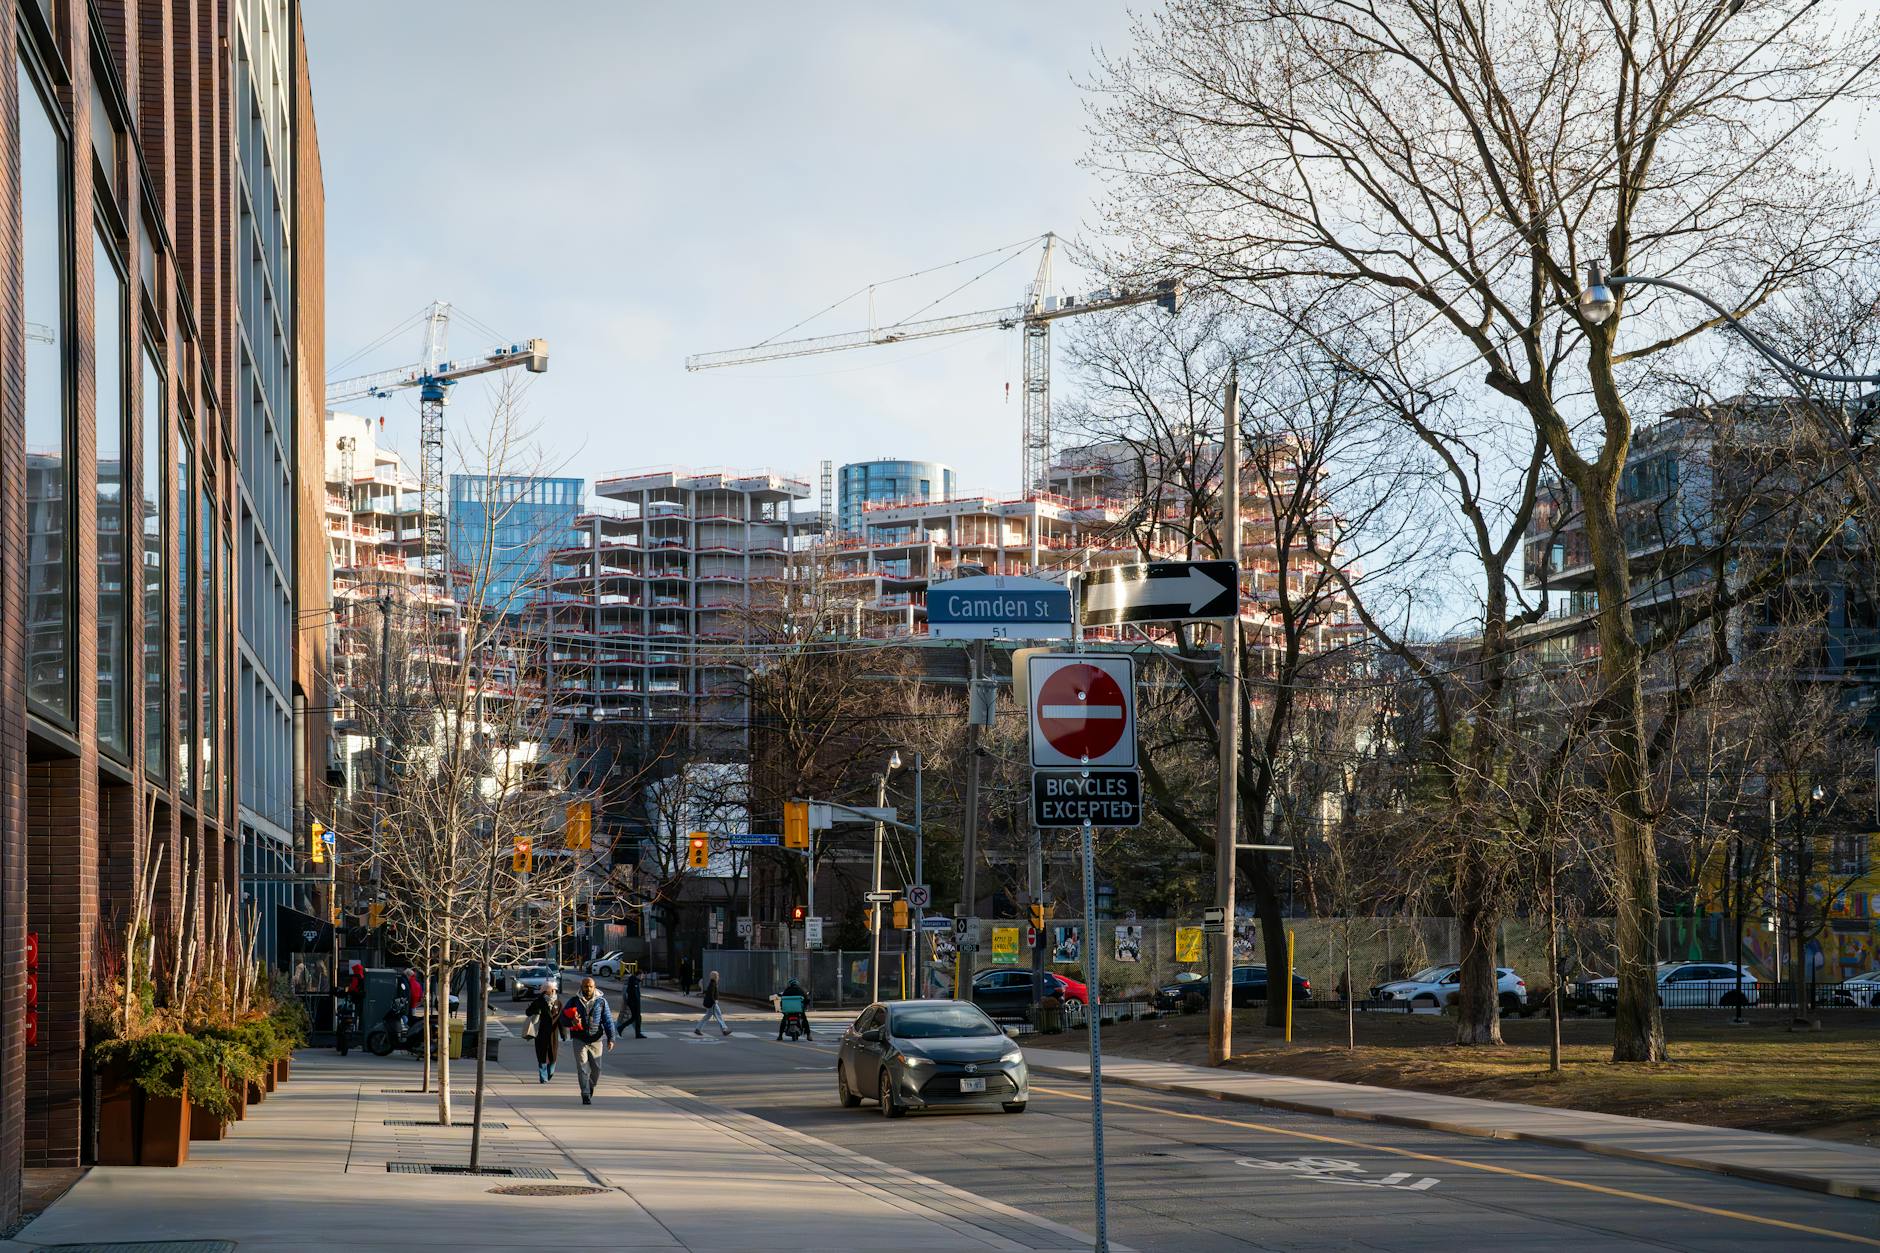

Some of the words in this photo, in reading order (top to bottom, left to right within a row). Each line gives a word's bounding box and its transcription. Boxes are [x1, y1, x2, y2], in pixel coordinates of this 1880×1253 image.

[948, 595, 1028, 617] Camden
[1034, 600, 1049, 617] St
[992, 627, 1008, 638] 51
[1046, 778, 1128, 796] BICYCLES
[1042, 801, 1133, 818] EXCEPTED
[739, 924, 752, 934] 30
